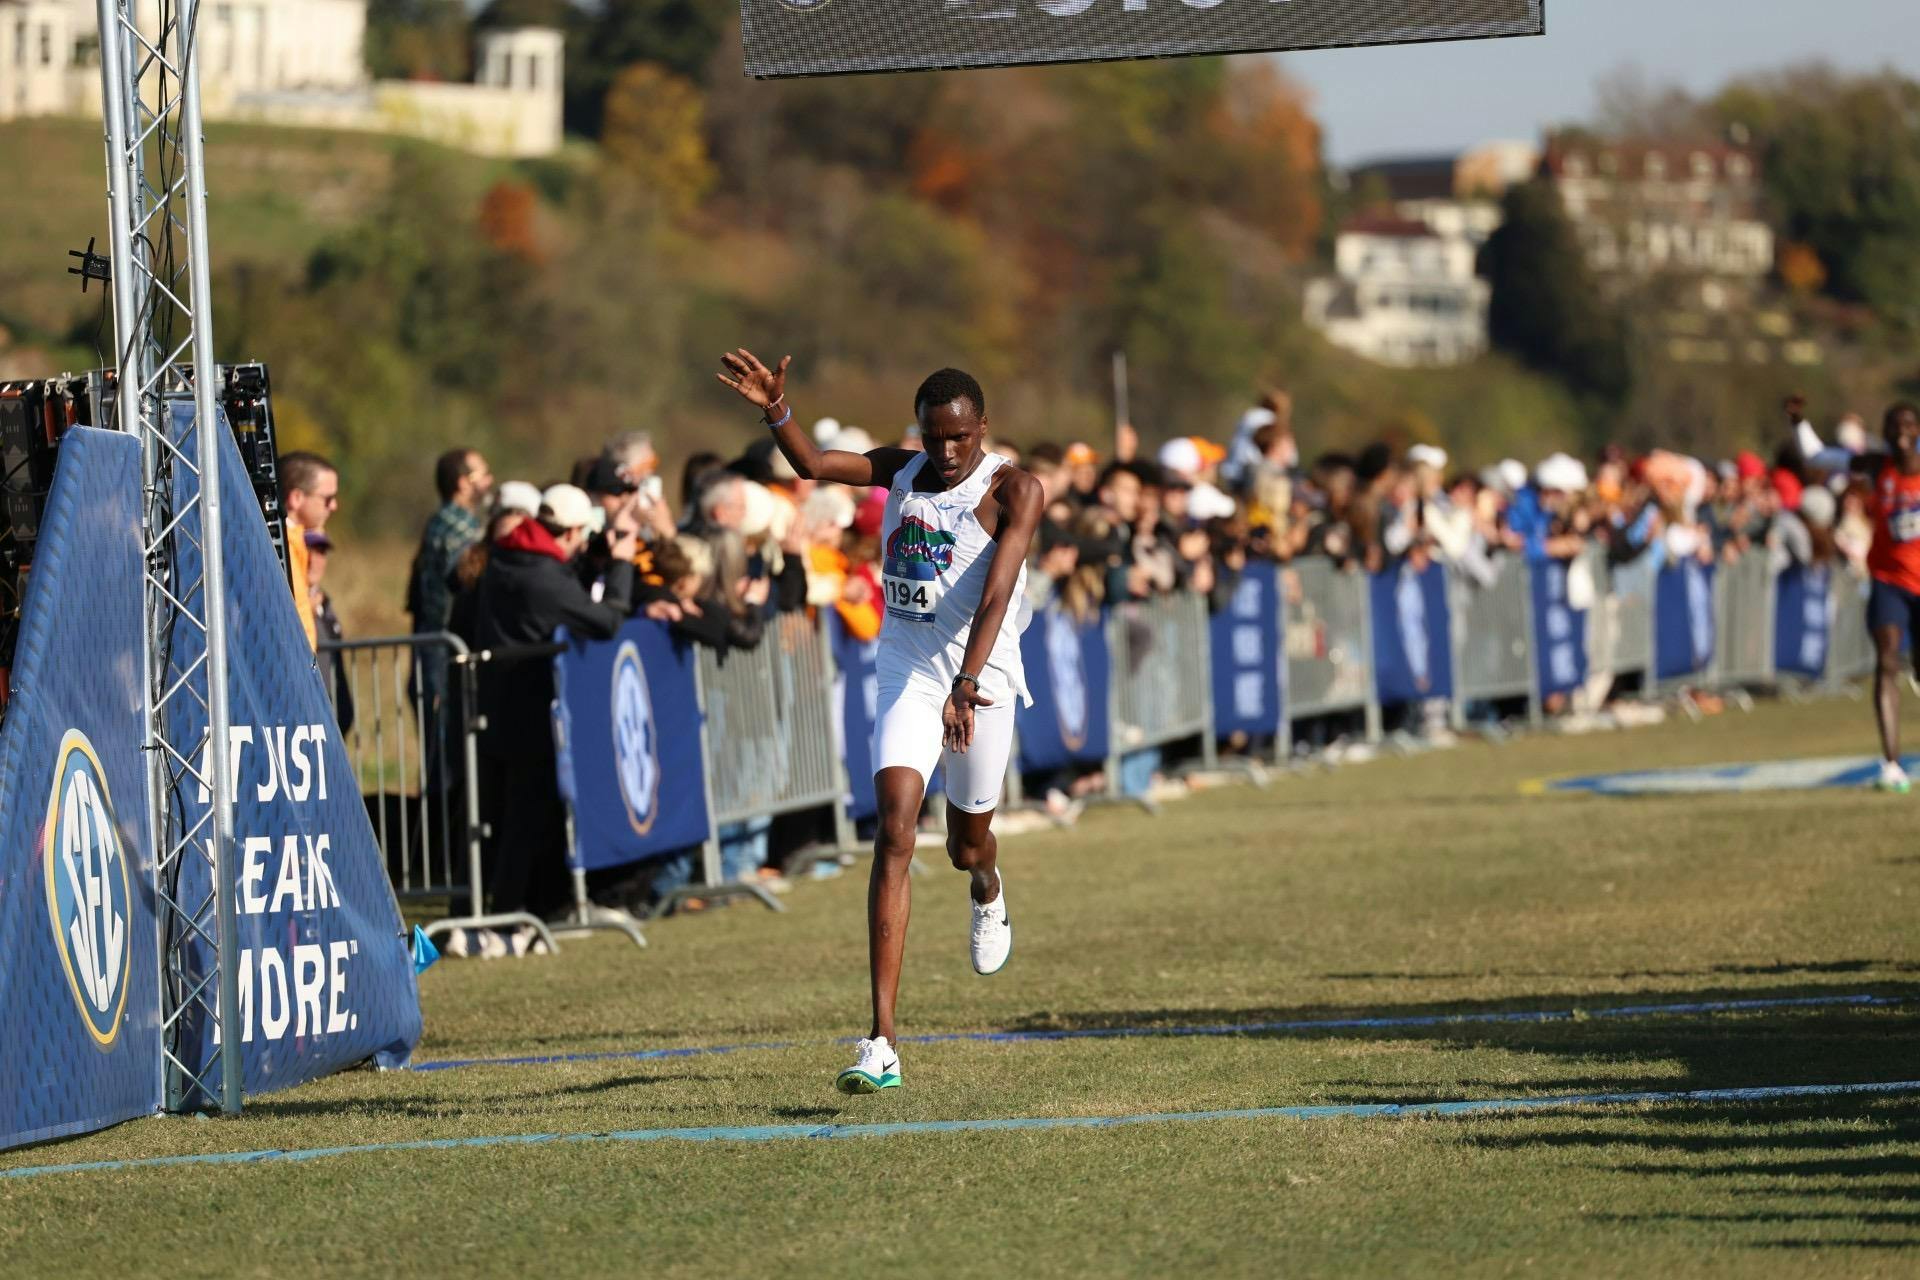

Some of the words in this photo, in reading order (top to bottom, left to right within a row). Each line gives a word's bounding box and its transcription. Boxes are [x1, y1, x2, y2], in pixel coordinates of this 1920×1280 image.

[884, 579, 929, 608] 1194
[257, 724, 327, 802] JUST
[62, 769, 124, 1012] SEC
